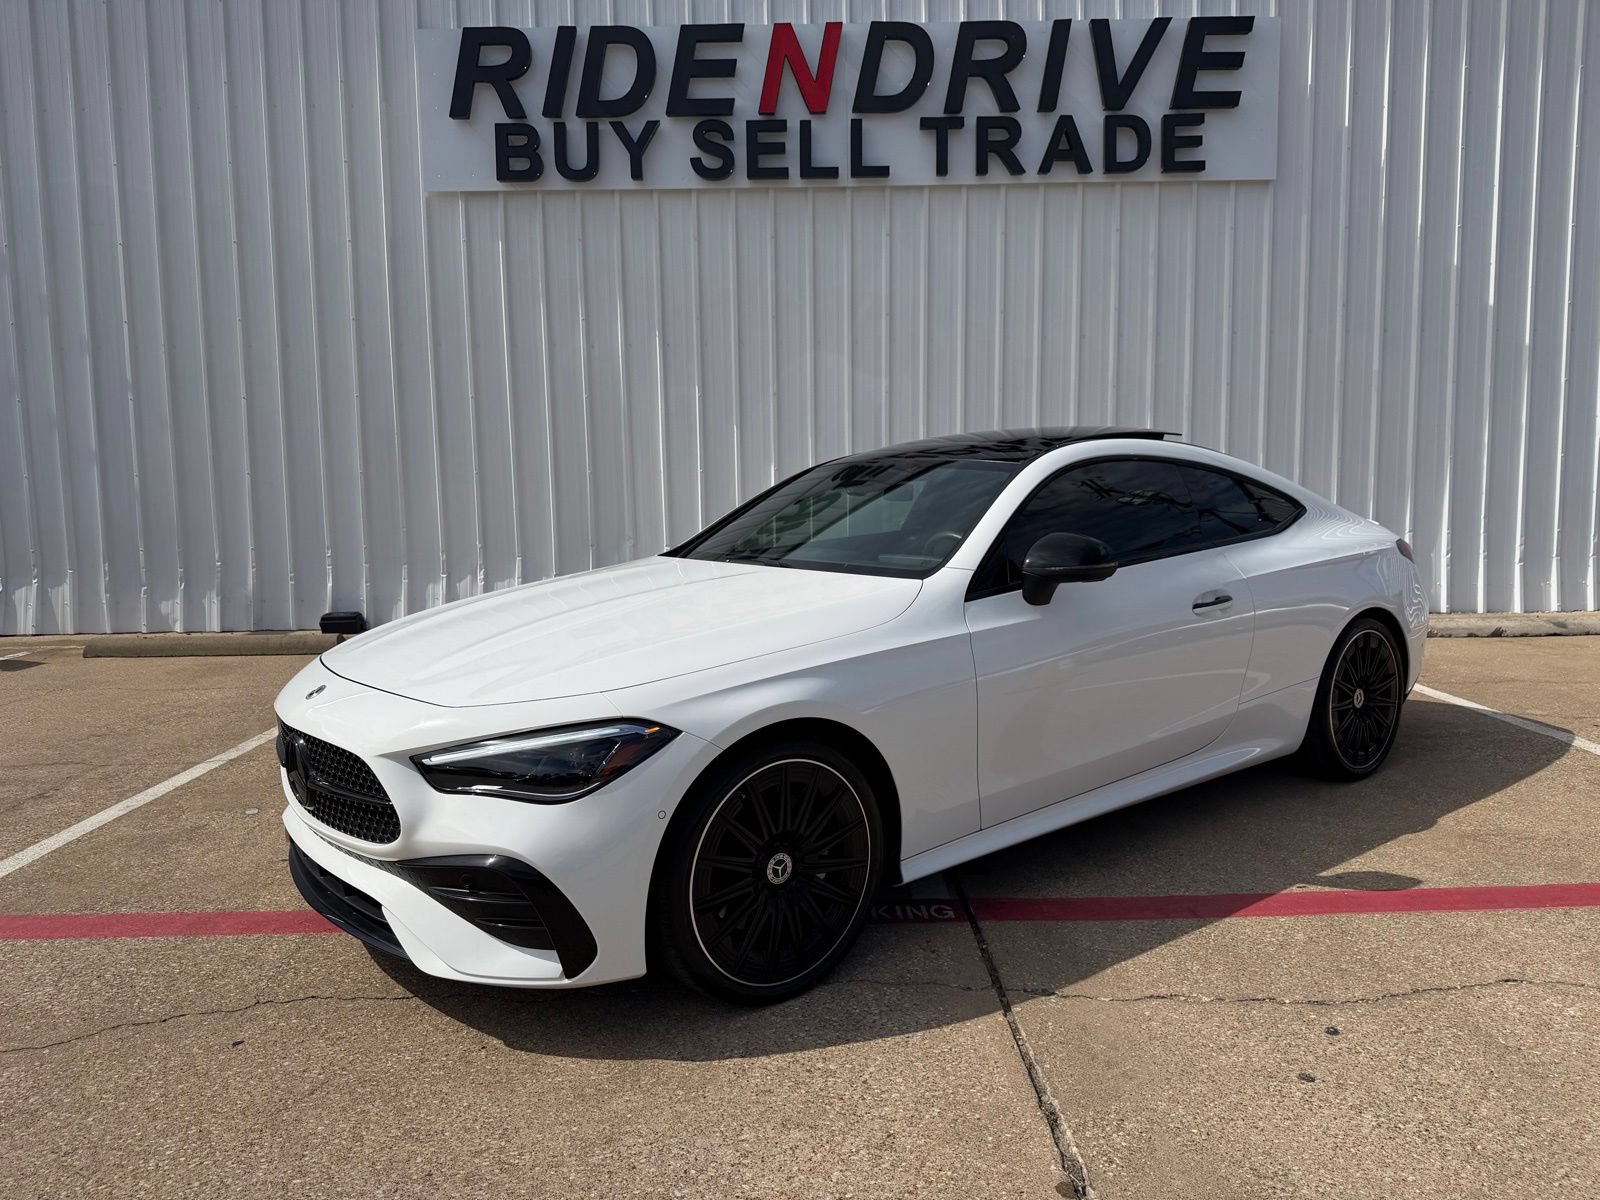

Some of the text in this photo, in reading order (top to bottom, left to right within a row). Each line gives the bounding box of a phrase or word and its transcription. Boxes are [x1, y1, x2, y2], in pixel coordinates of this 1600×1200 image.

[494, 113, 1206, 183] BUY SELL TRADE
